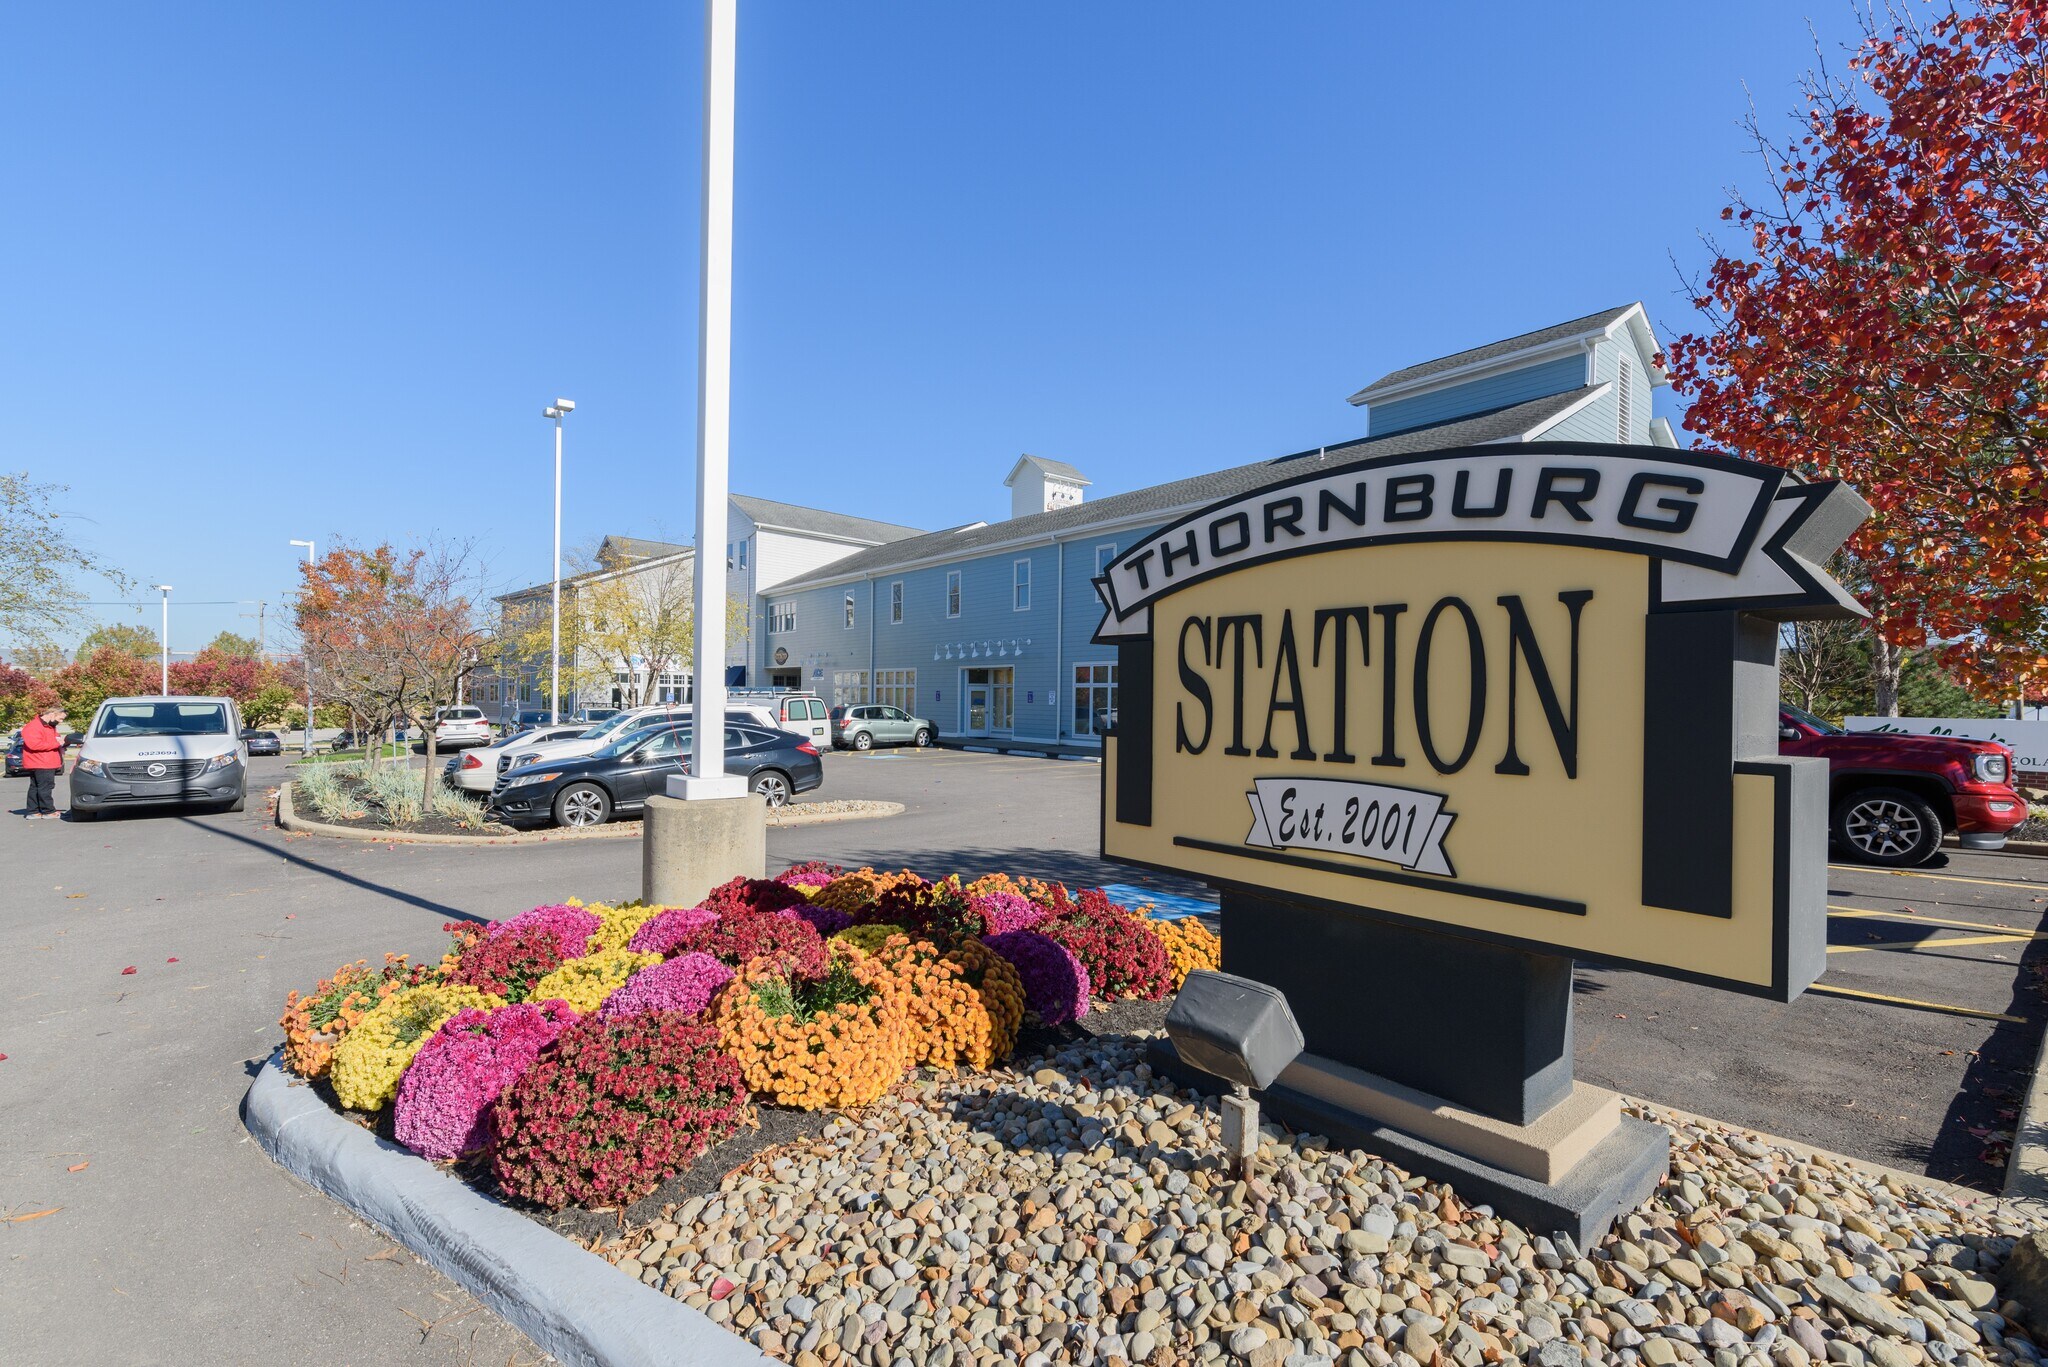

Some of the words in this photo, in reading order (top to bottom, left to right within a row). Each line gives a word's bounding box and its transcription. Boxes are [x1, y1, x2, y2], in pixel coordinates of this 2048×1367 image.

[1124, 466, 1705, 591] THORNBURG
[1176, 590, 1594, 780] STATION
[1278, 787, 1333, 842] Est.
[1341, 796, 1417, 855] 2001
